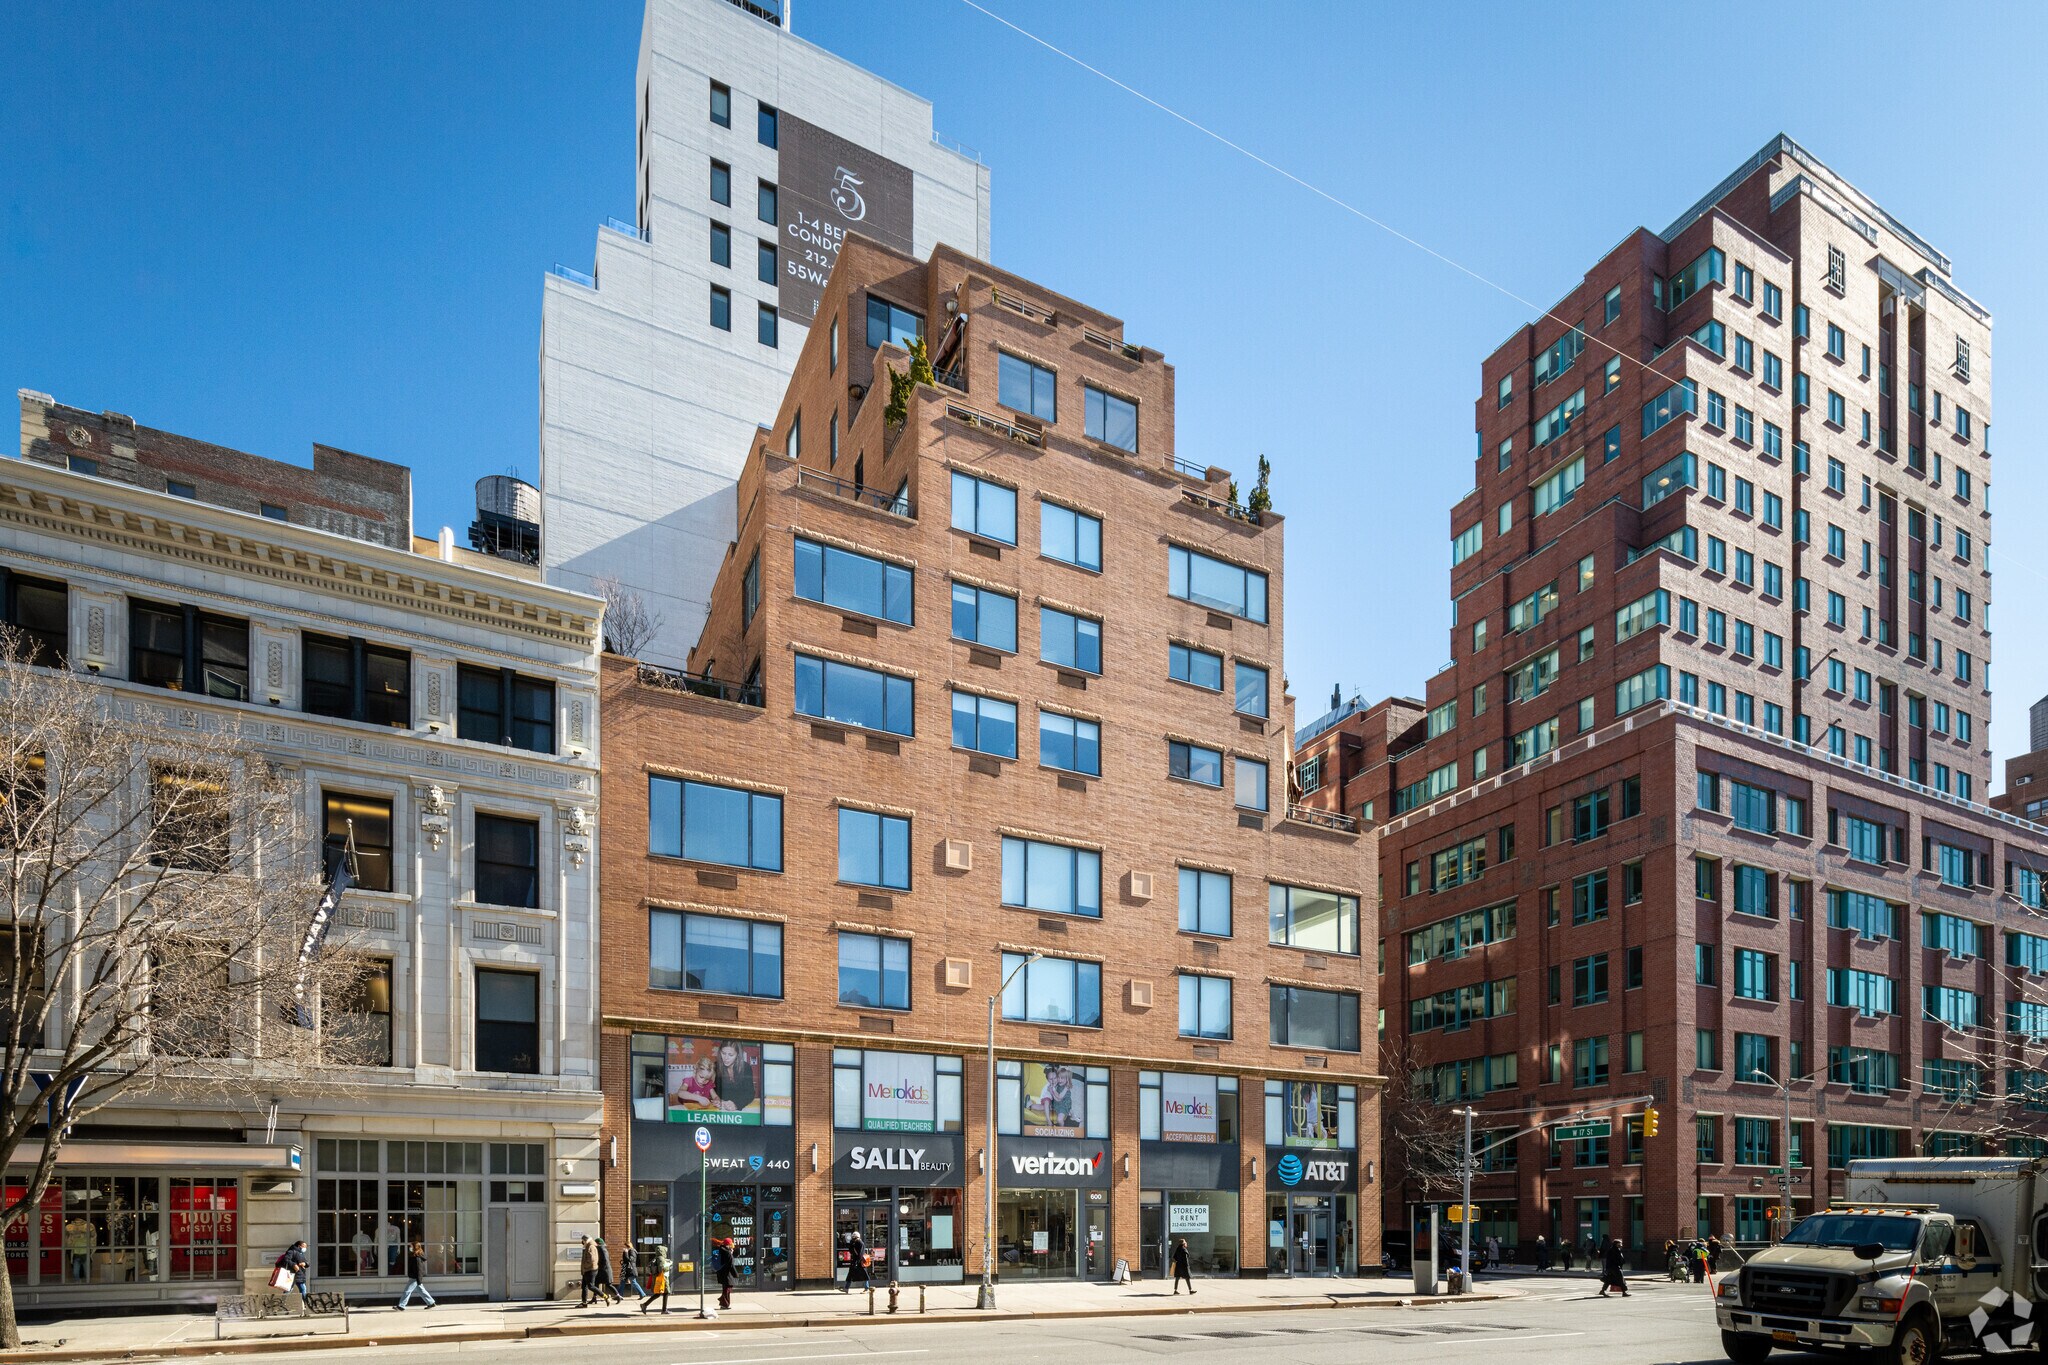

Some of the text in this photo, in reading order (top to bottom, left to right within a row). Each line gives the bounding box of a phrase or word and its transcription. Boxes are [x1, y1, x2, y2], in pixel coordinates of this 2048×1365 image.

[798, 211, 820, 231] 1-4
[805, 249, 834, 269] 212.
[868, 1078, 930, 1101] Metrokids
[1165, 1096, 1213, 1116] Metrokids
[687, 1112, 743, 1124] LEARNING
[867, 1120, 932, 1131] QUALIFIED TEACHERS
[1034, 1127, 1075, 1137] SOCIALIZING
[1586, 1128, 1593, 1136] St
[1165, 1133, 1193, 1141] ACCEPTING
[1194, 1134, 1207, 1142] AGES
[850, 1146, 952, 1171] SALLY BEAUTY
[1011, 1151, 1094, 1176] verizon
[703, 1158, 790, 1170] SWEAT 440
[1304, 1160, 1349, 1182] AT&T
[1173, 1207, 1207, 1215] STORE FOR
[731, 1216, 753, 1225] CLASSES
[10, 1225, 53, 1234] STES
[194, 1224, 232, 1233] STYES
[733, 1227, 751, 1236] START
[733, 1237, 751, 1246] EVERY
[739, 1247, 747, 1256] 10
[936, 1258, 962, 1266] SALLY
